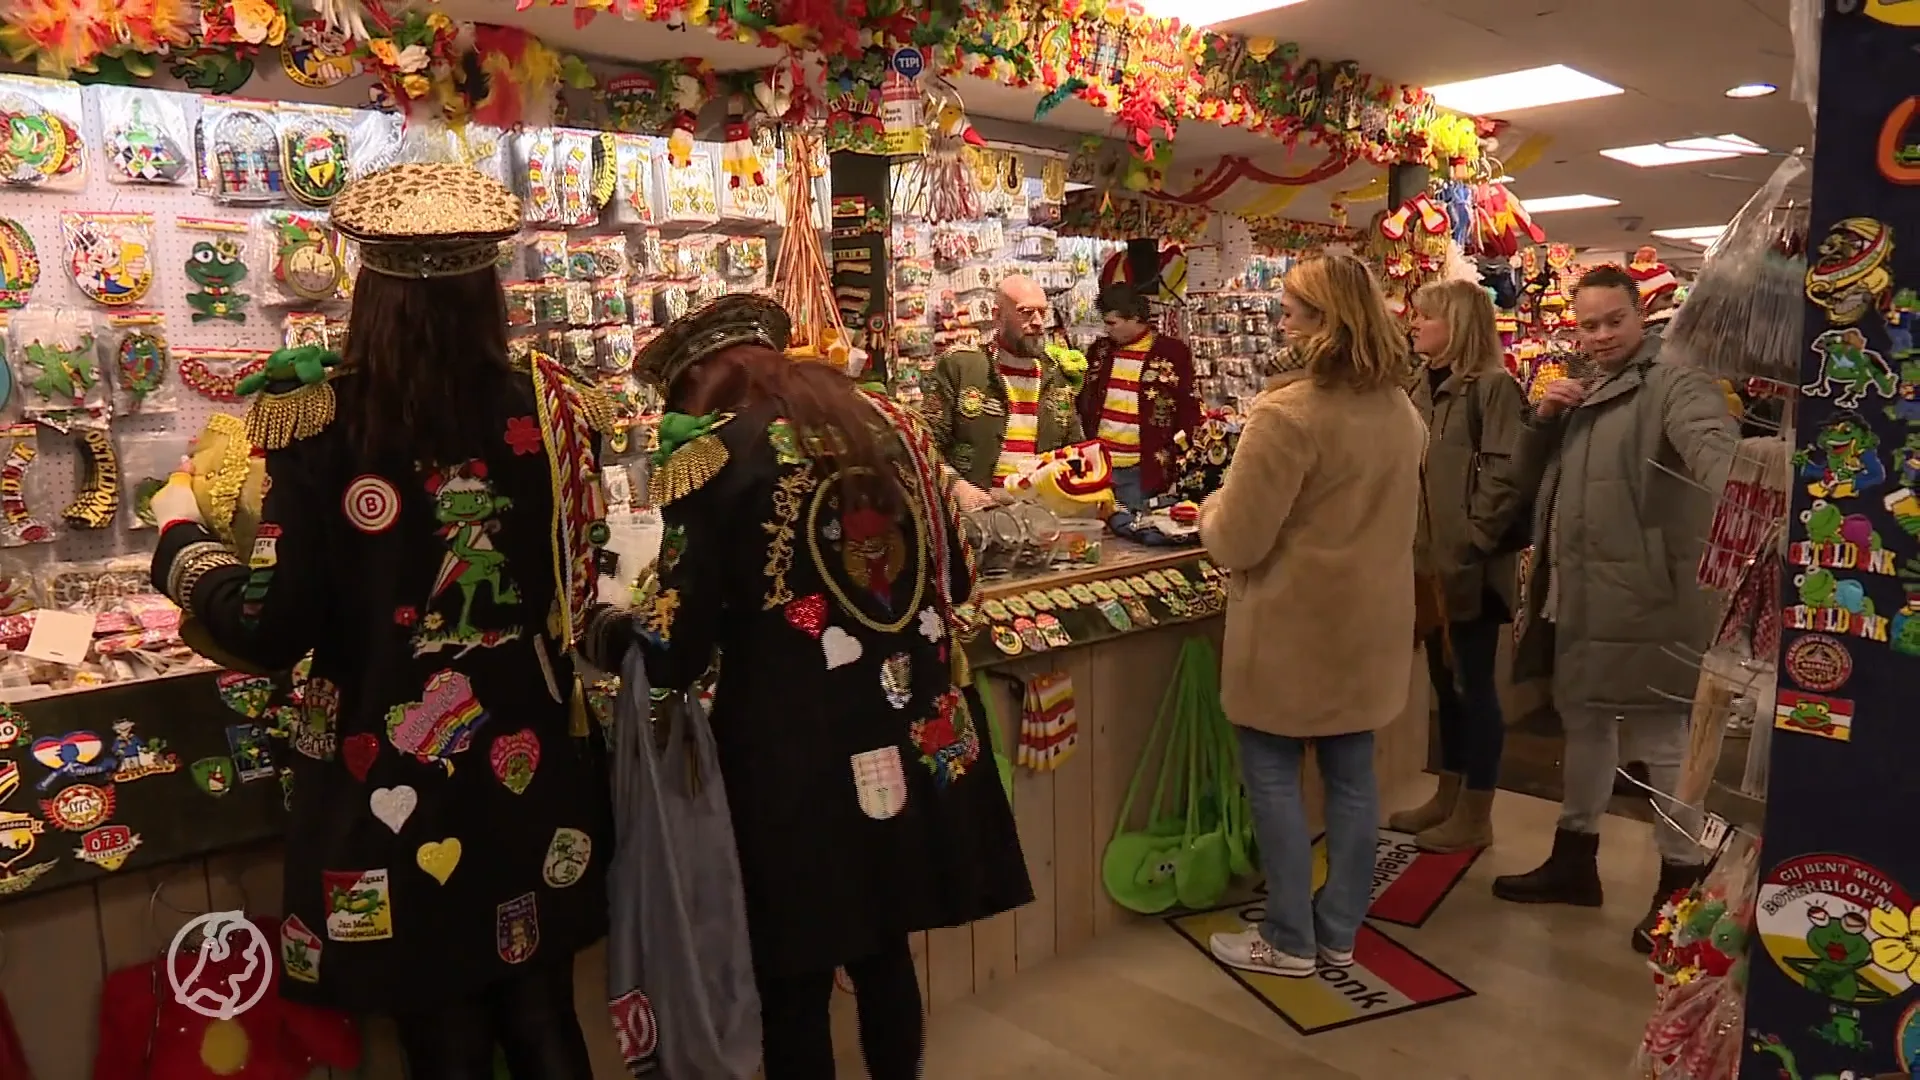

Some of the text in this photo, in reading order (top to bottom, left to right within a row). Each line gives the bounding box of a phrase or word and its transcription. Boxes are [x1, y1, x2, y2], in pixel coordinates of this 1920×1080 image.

[898, 57, 920, 69] TIP!
[365, 497, 378, 512] B
[1780, 862, 1893, 894] GIJ BENT MUN
[1761, 879, 1895, 916] BOTERBLOEM
